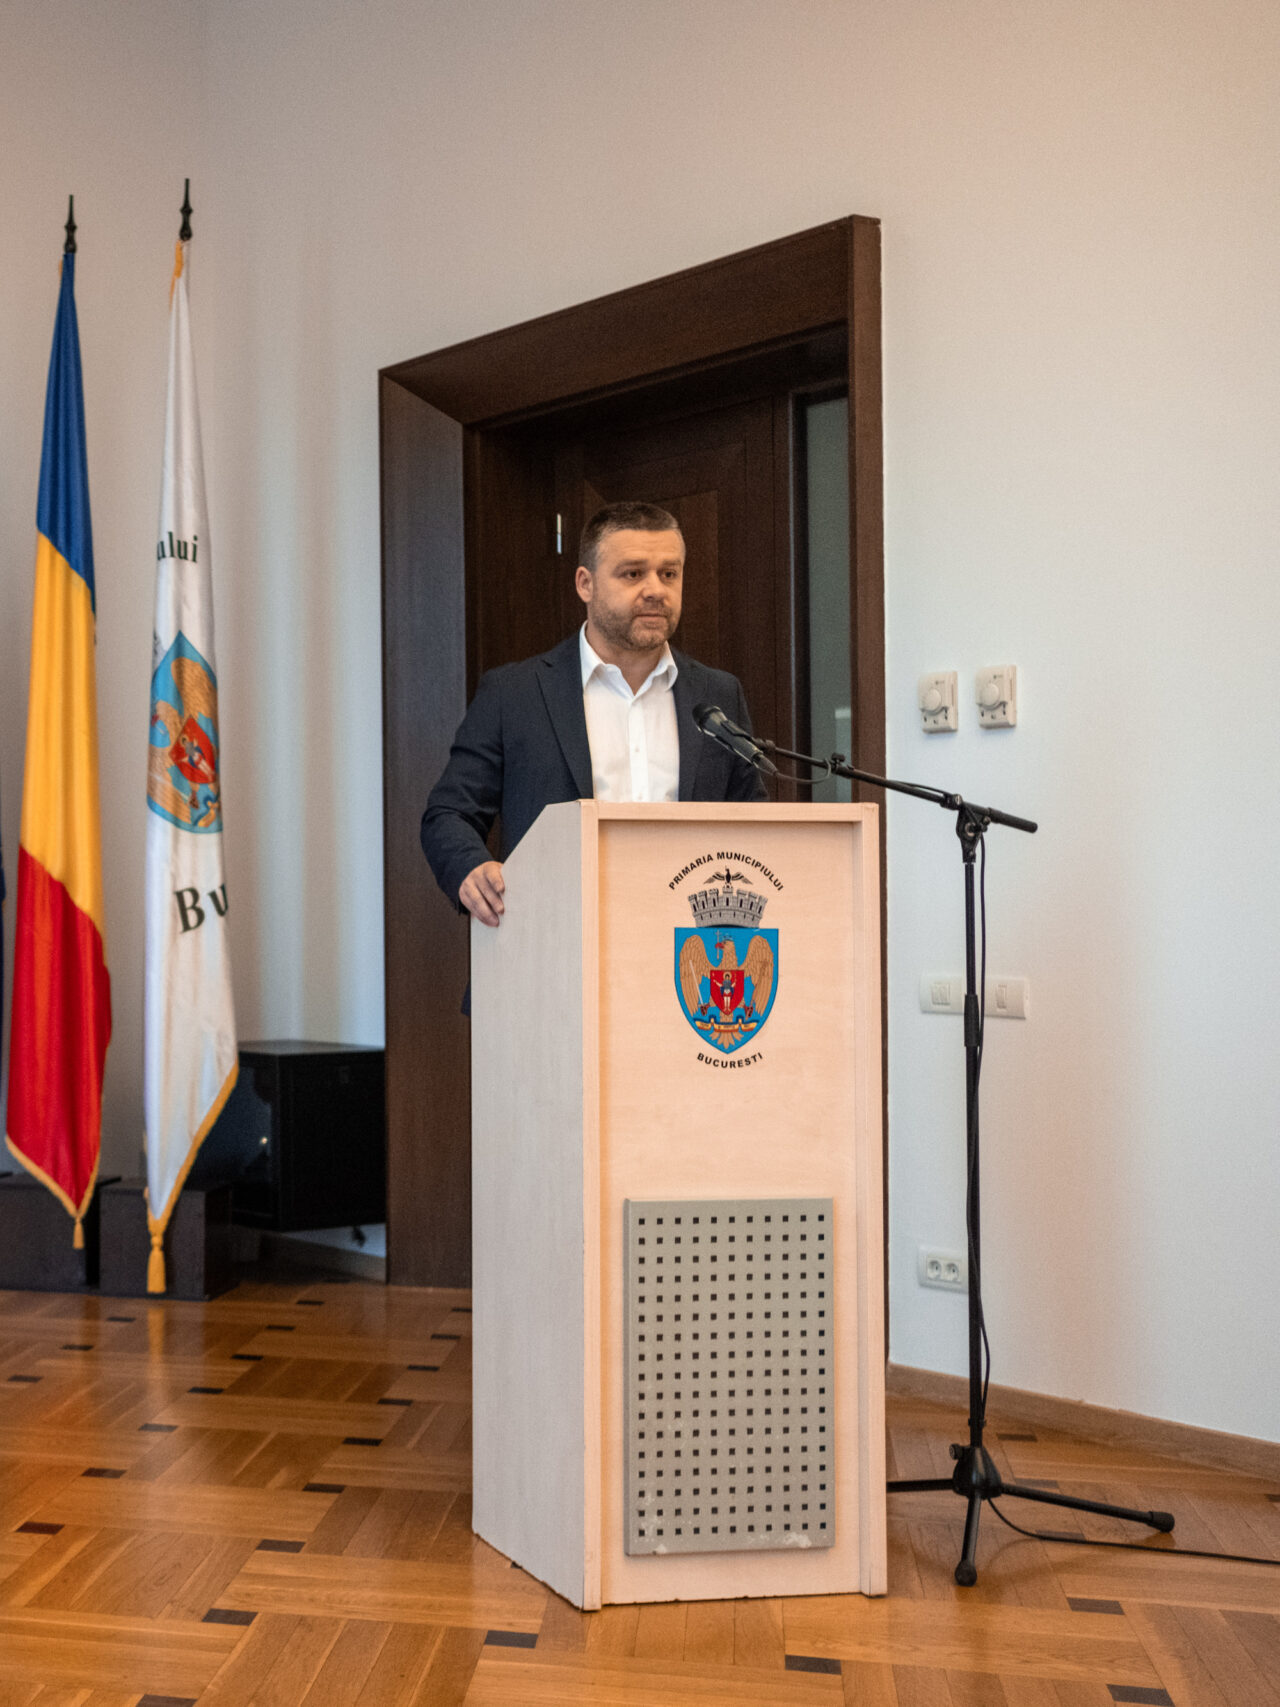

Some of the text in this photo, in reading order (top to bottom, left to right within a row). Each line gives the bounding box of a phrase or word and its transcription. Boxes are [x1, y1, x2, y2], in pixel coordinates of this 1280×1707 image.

[668, 852, 784, 891] PRIMARIA MUNICIPIULUI
[697, 1052, 763, 1068] BUCURESTI
